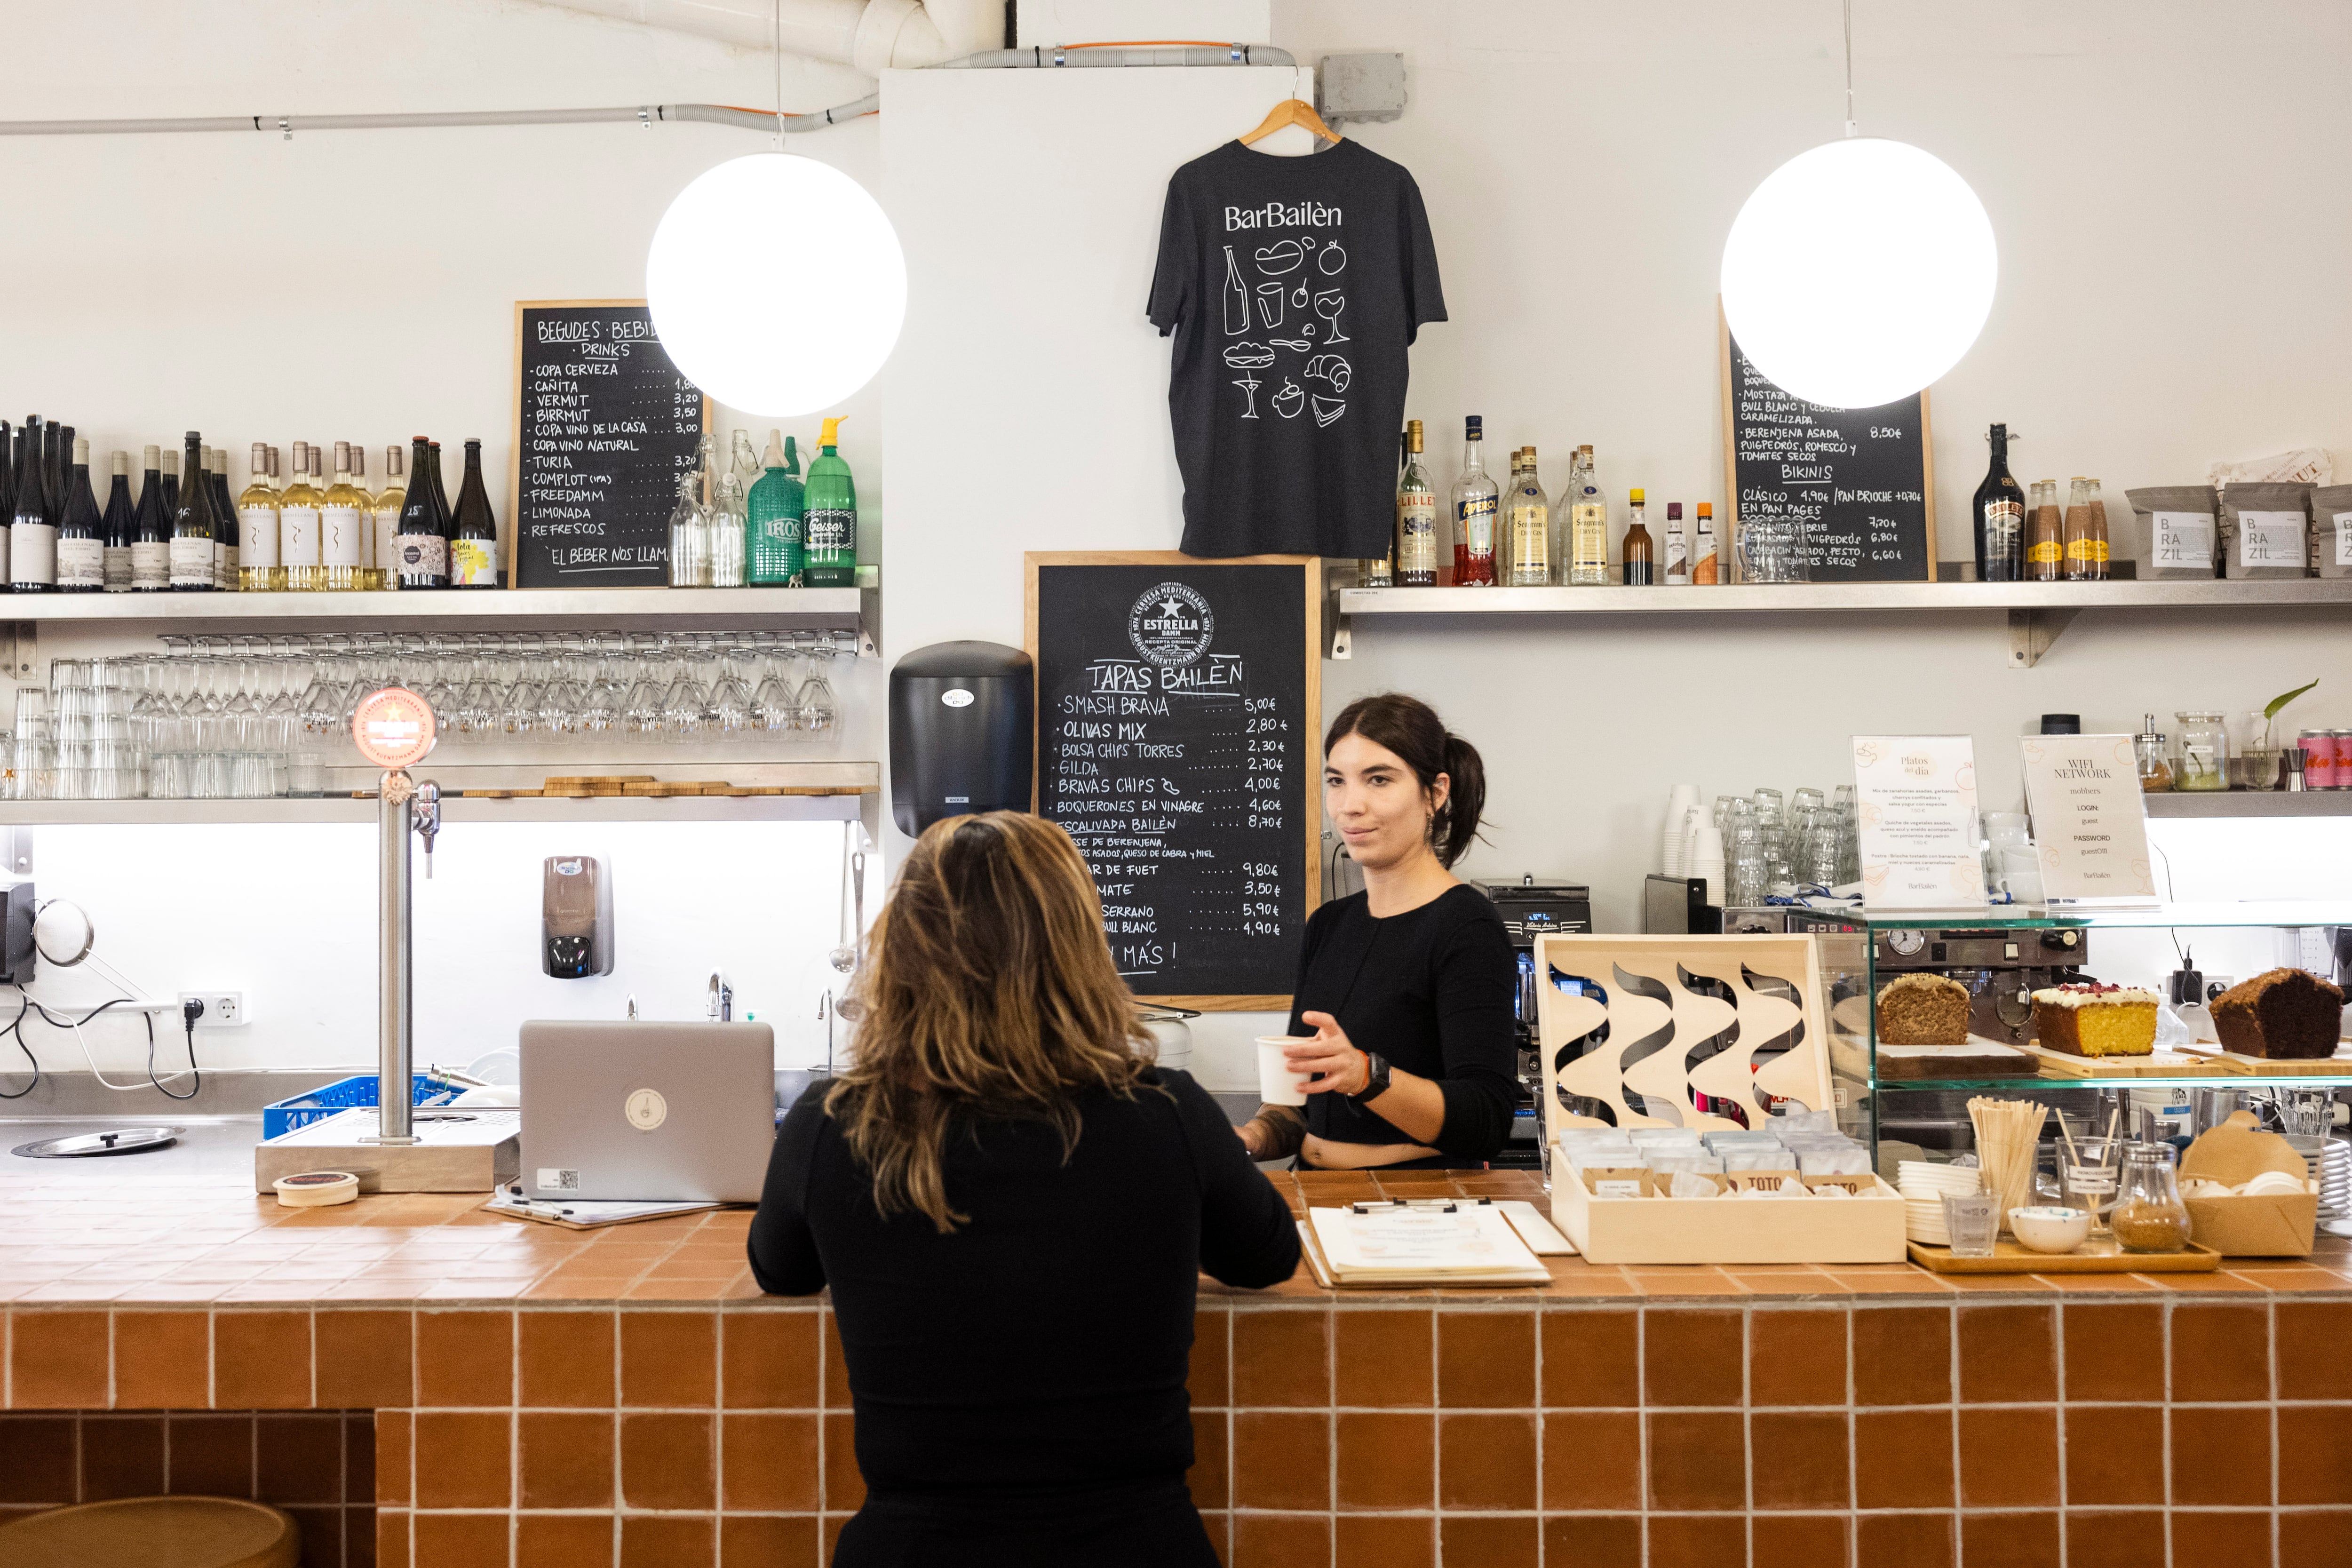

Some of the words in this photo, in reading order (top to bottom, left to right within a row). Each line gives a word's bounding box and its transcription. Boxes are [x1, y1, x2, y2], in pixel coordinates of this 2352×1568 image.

[1225, 201, 1342, 231] BarBailèn
[538, 321, 600, 342] BEGUDES
[581, 342, 629, 356] DRINKS
[536, 365, 561, 376] COPA
[565, 364, 618, 376] CERVEZA
[535, 379, 577, 393] CAÑITA
[537, 395, 589, 407] VERMUT
[674, 393, 698, 405] 3,20
[1744, 388, 1787, 401] MOSTAZA
[1765, 401, 1797, 412] BLANC
[537, 408, 590, 422] BIRRMUT
[674, 407, 696, 419] 3,50
[535, 424, 562, 436] COPA
[566, 424, 588, 435] VINO
[593, 424, 605, 435] DE
[609, 423, 619, 433] LA
[621, 422, 647, 434] CASA
[675, 422, 697, 434] 3,00
[1745, 427, 1803, 440] BERENJENA
[1807, 429, 1843, 441] ASADA,
[1870, 426, 1901, 438] 8,50€
[534, 440, 557, 452] COPA
[559, 439, 582, 451] VINO
[588, 439, 639, 452] NATURAL
[1805, 442, 1847, 453] ROMESCO
[533, 456, 572, 469] TURIA
[675, 456, 696, 466] 3,20
[1739, 452, 1783, 461] TOMATES
[1788, 452, 1816, 461] SECOS
[1782, 464, 1832, 479] BIKINIS
[533, 473, 587, 486] COMPLOT
[590, 475, 611, 485] (IPA)
[530, 489, 604, 502] FREEDAMM
[1743, 486, 1787, 502] CLÁSICO
[1801, 490, 1828, 502] 4,90€
[1857, 490, 1892, 503] BRIOCHE
[533, 507, 590, 519] LIMONADA
[1463, 500, 1496, 516] APEROL
[1741, 503, 1757, 513] EN
[1762, 503, 1782, 513] PAN
[1788, 504, 1821, 515] PAGES
[809, 518, 845, 532] Geiser
[1576, 518, 1604, 527] Seagram's
[1869, 517, 1896, 528] 7,20€
[2161, 519, 2169, 529] B
[2247, 518, 2255, 529] B
[532, 523, 605, 537] REFRESCOS
[1871, 533, 1897, 542] 6,80€
[2162, 534, 2180, 544] RA
[2249, 533, 2268, 543] RA
[570, 548, 607, 564] BEBER
[612, 546, 633, 562] NOS
[1830, 548, 1865, 557] PESTO,
[1872, 550, 1901, 560] 6,60€
[2161, 549, 2182, 560] ZIL
[2249, 548, 2270, 559] ZIL
[1827, 557, 1857, 567] SECOS
[1135, 590, 1160, 614] CERVESA
[1144, 620, 1198, 630] ESTRELLA
[1133, 633, 1152, 656] AUGUST
[1150, 651, 1196, 665] KUENTZMANN
[1195, 634, 1209, 653] DAMM
[1086, 665, 1152, 692] TAPAS
[1161, 657, 1242, 689] BAILÈN
[1064, 695, 1114, 716] SMASH
[1121, 697, 1169, 716] BRAVA
[1245, 698, 1275, 714] 5,00€
[1064, 721, 1112, 738] OLIVAS
[1119, 723, 1146, 740] MIX
[1062, 743, 1094, 757] BOLSA
[1098, 743, 1129, 758] CHIPS
[1135, 743, 1184, 758] TORRES
[1060, 761, 1098, 775] GILDA
[1248, 757, 1283, 772] 2,70€
[1915, 767, 1929, 775] día
[2068, 759, 2093, 769] WIFI
[2055, 769, 2111, 779] NETWORK
[1059, 779, 1109, 794] BRAVAS
[1117, 777, 1154, 792] CHIPS
[1245, 777, 1280, 792] 4,00€
[1057, 801, 1135, 814] BOQUERONES
[1142, 799, 1155, 811] EN
[1161, 801, 1204, 812] VINAGRE
[1249, 798, 1281, 812] 4,60€
[1132, 815, 1176, 830] BAILÈN
[1249, 815, 1282, 828] 8,70€
[1107, 838, 1166, 848] BERENJENA,
[1106, 865, 1120, 876] DE
[1127, 865, 1158, 875] FUET
[1243, 863, 1278, 877] 9,80€
[1245, 881, 1280, 897] 3,50€
[1100, 905, 1153, 918] SERRANO
[1244, 903, 1279, 916] 5,90€
[1122, 921, 1157, 933] BLANC
[1244, 922, 1279, 936] 4,90€
[1748, 1177, 1782, 1191] TOTO
